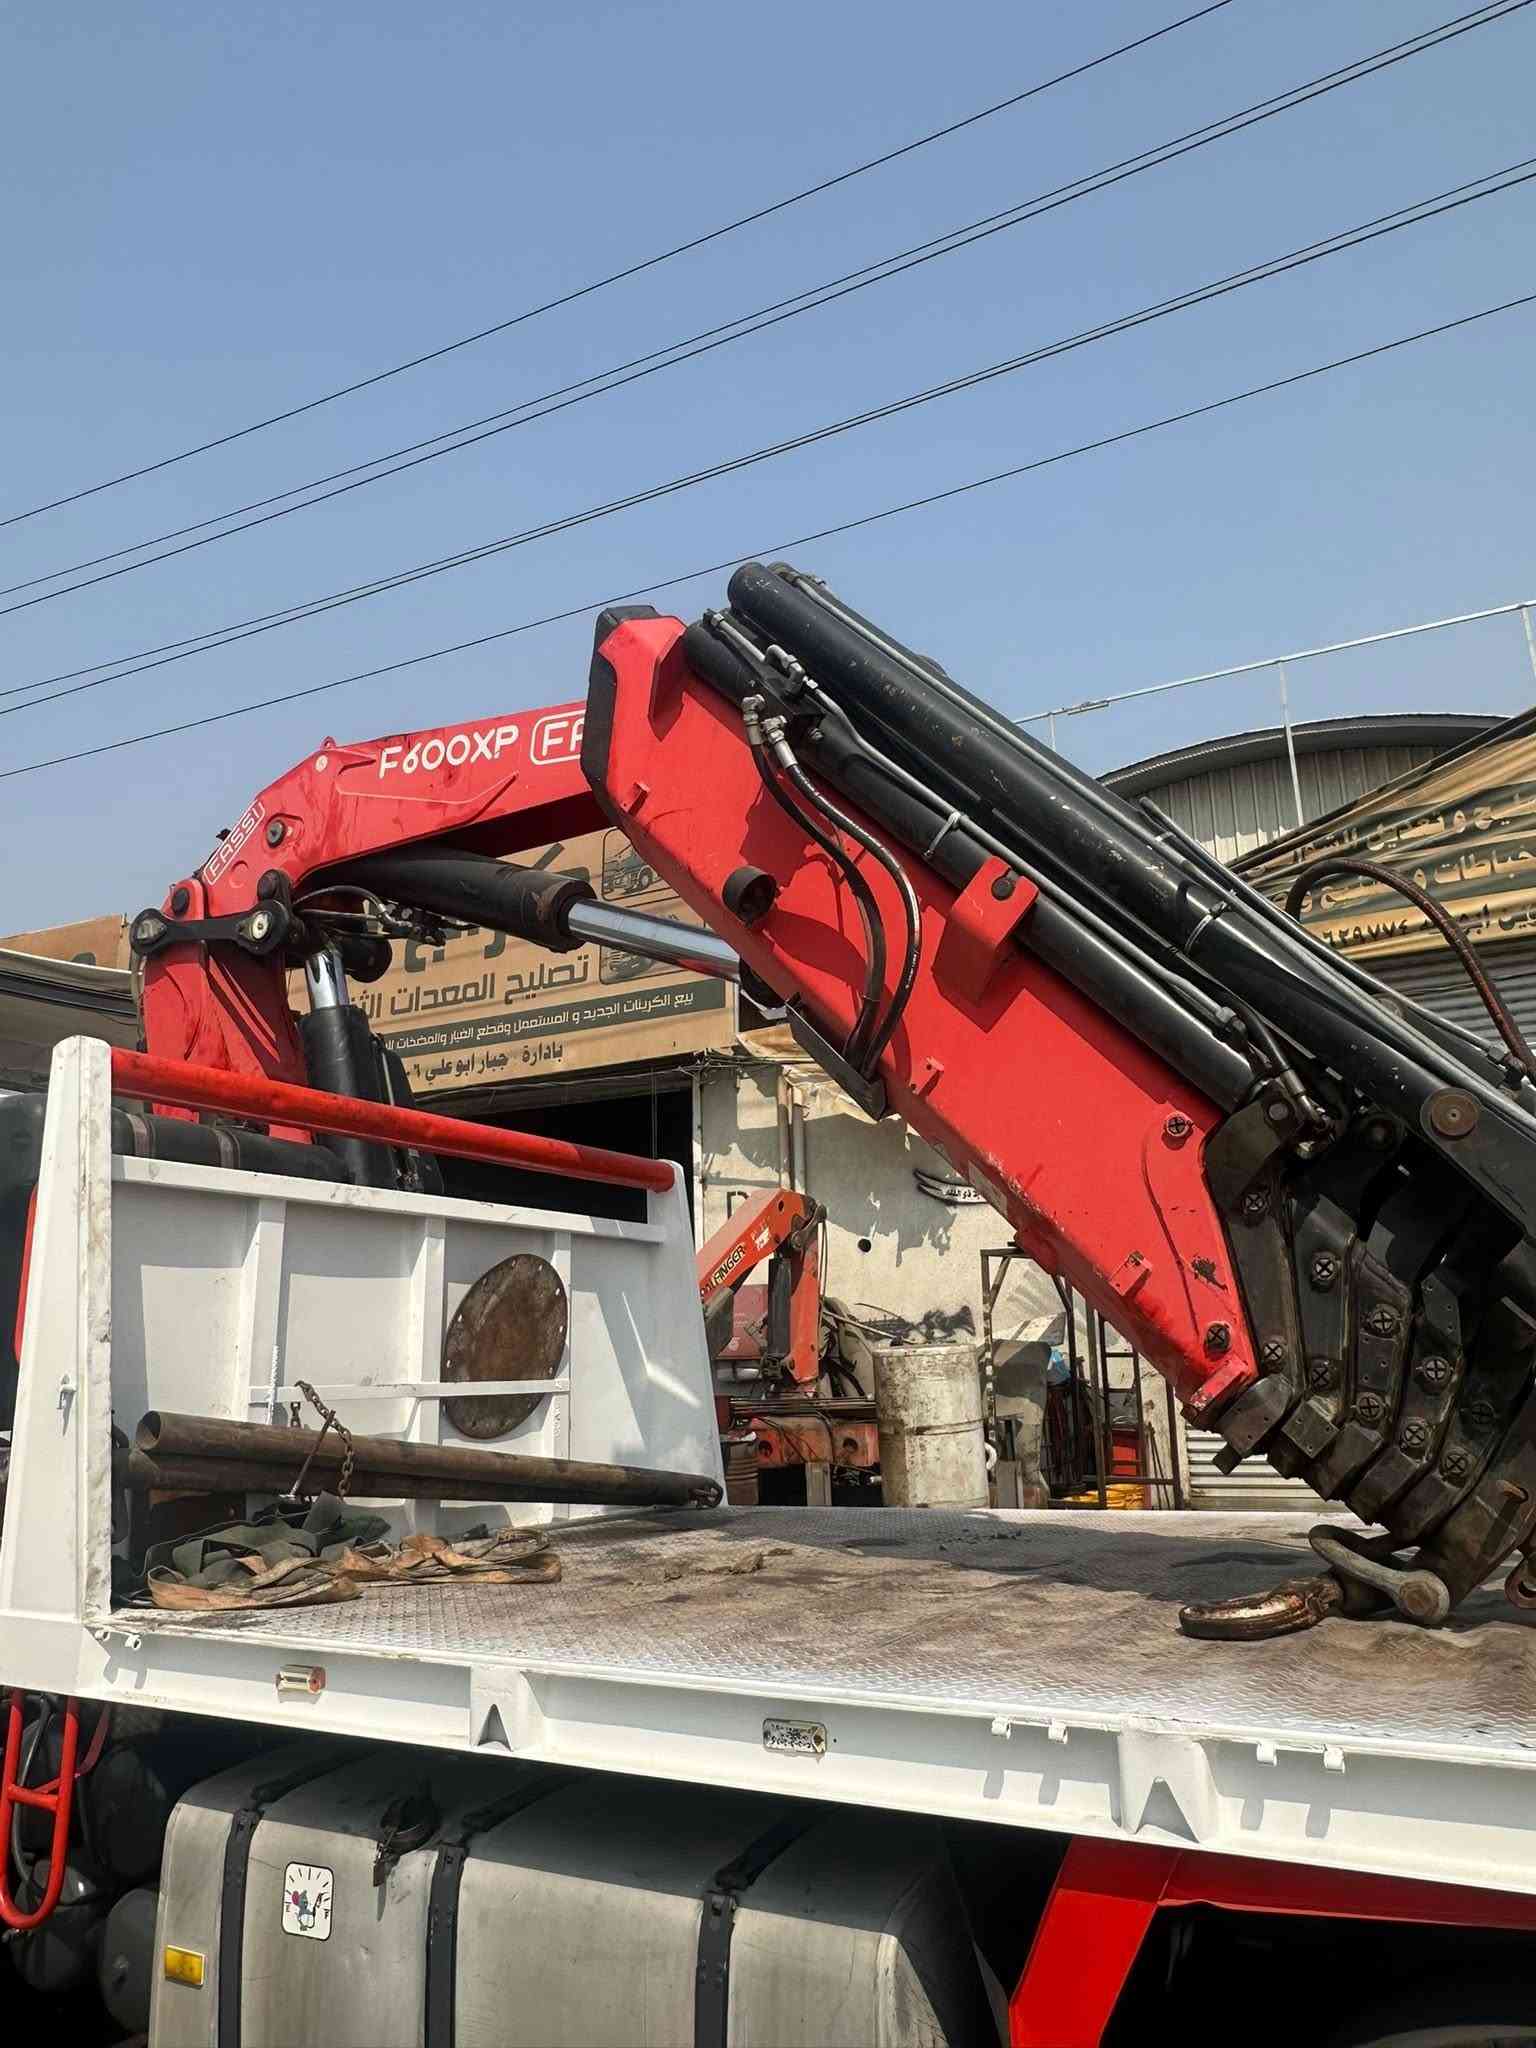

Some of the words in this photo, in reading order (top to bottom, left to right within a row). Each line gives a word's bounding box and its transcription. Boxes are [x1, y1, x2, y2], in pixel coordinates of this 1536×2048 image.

[379, 724, 520, 779] F600XP
[208, 806, 260, 877] FASSI
[391, 972, 495, 1016] المعدات
[505, 954, 589, 1005] تصليح
[583, 1003, 620, 1021] الجديد
[674, 991, 694, 1008] بيع
[476, 1023, 511, 1040] وقطع
[513, 1011, 569, 1033] المستعمل
